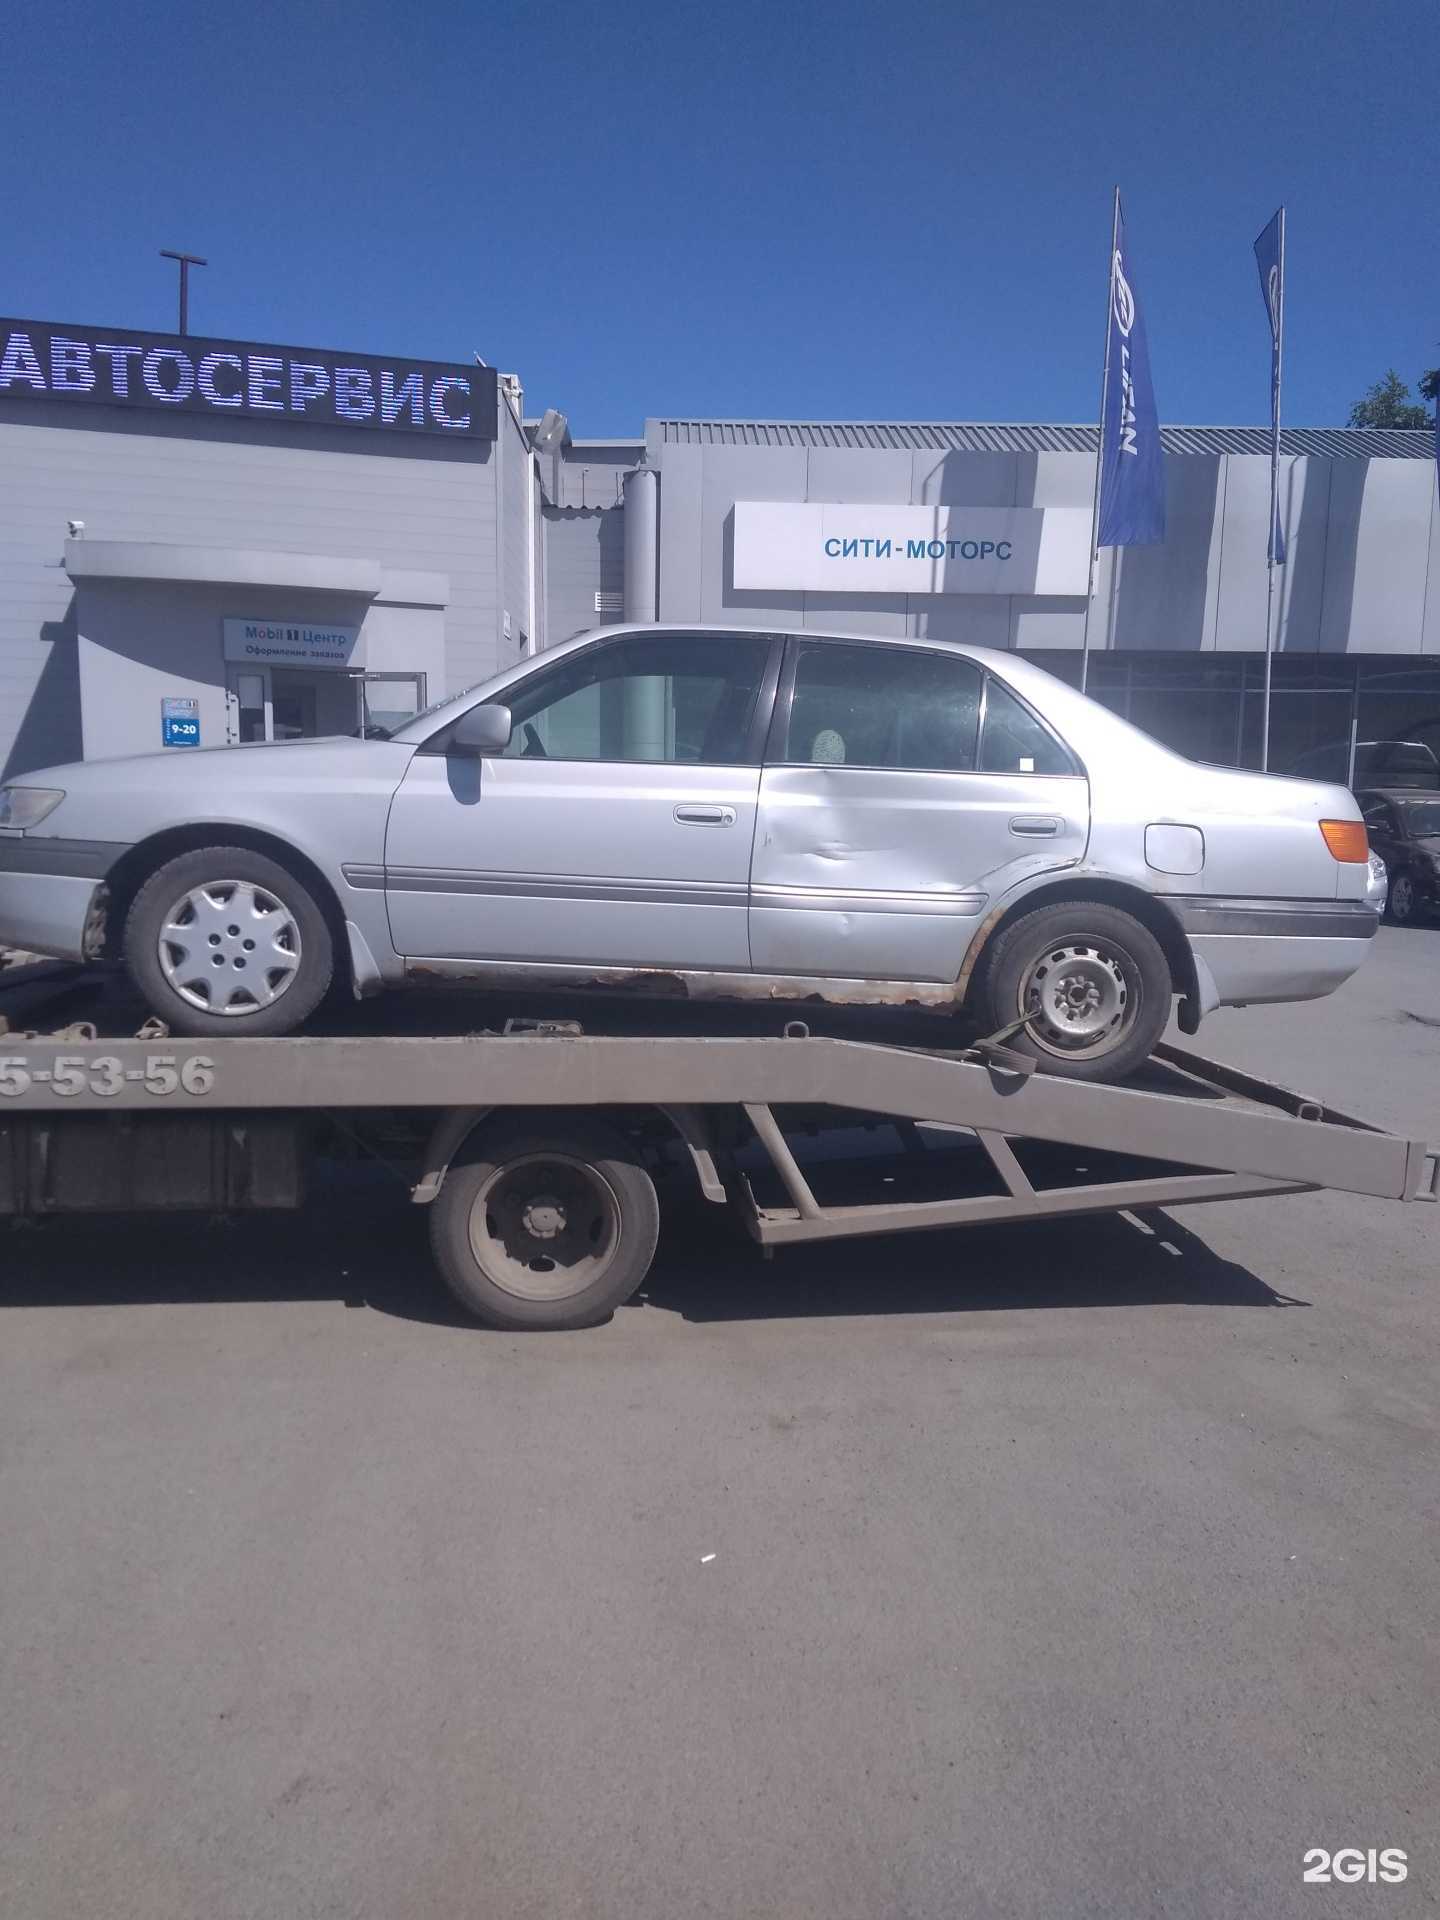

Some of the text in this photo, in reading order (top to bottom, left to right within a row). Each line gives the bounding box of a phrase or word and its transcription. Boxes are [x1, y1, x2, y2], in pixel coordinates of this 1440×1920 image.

[0, 333, 471, 429] АВТОСЕРВИС
[824, 538, 1012, 561] СИТИ-МОТОРС
[245, 626, 283, 640] Mobil
[303, 630, 346, 646] Центр
[245, 645, 307, 657] Оформление
[172, 724, 196, 734] 9-20
[0, 1055, 216, 1096] 5-53-56
